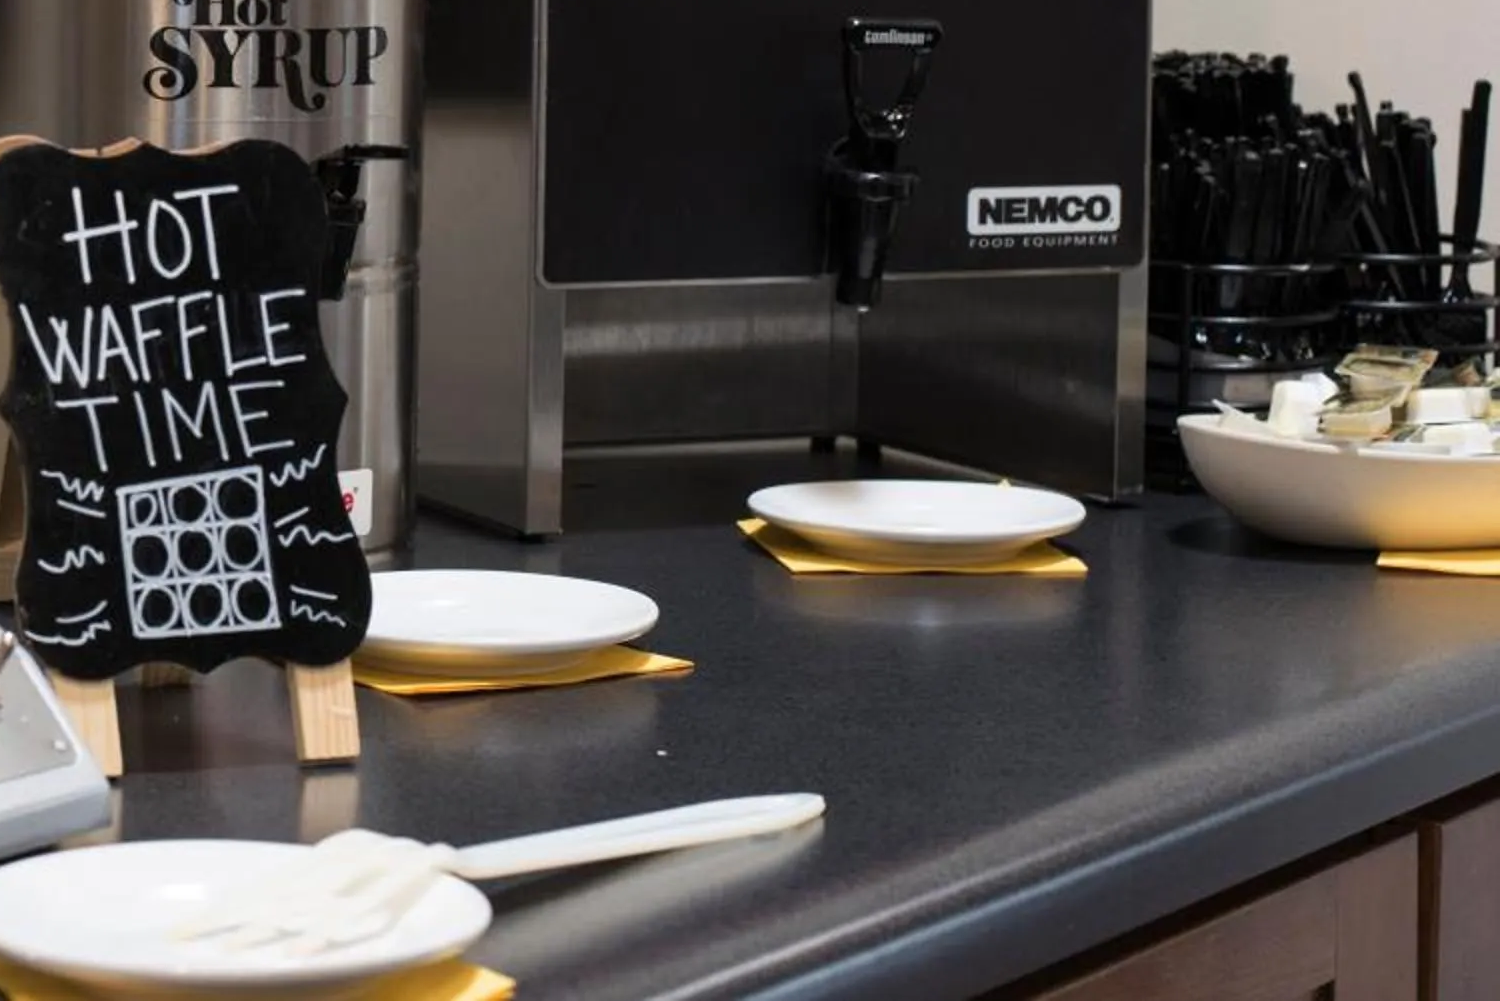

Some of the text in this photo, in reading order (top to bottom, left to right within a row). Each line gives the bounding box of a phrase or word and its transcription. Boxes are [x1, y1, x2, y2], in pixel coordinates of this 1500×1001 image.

[143, 26, 388, 112] SYRUP
[63, 185, 239, 283] HOT
[969, 234, 1119, 248] FOOD EQUIPMENT
[978, 195, 1111, 225] NEMCO
[19, 288, 306, 388] WAFFLE
[55, 380, 295, 472] TIME
